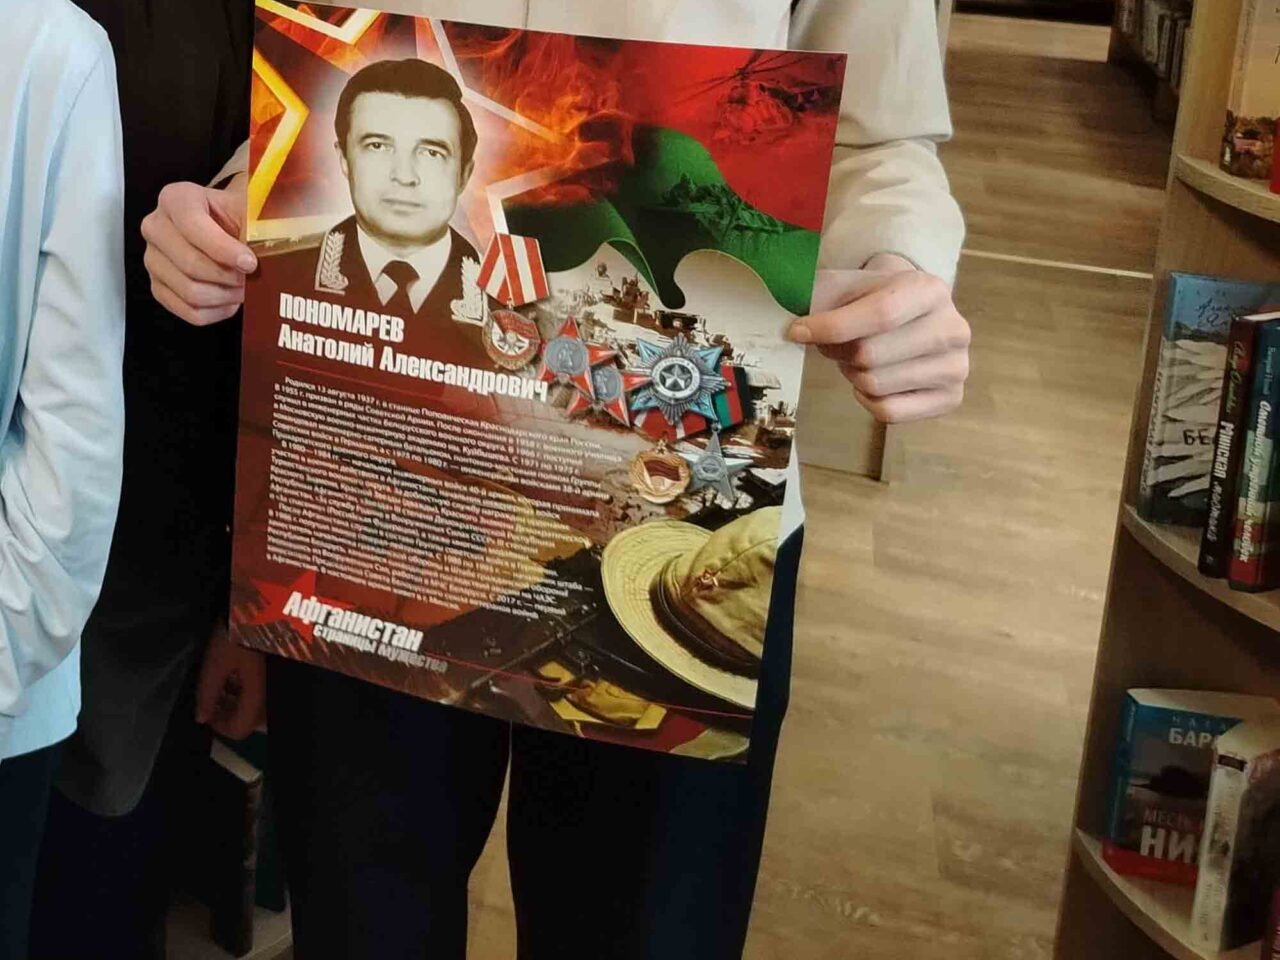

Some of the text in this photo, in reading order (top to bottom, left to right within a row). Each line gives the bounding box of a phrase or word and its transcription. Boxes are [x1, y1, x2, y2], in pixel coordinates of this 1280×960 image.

[279, 292, 405, 343] ПОНОМАРЕВ
[277, 323, 549, 402] Анатолий Александрович
[282, 591, 424, 652] Афганистан
